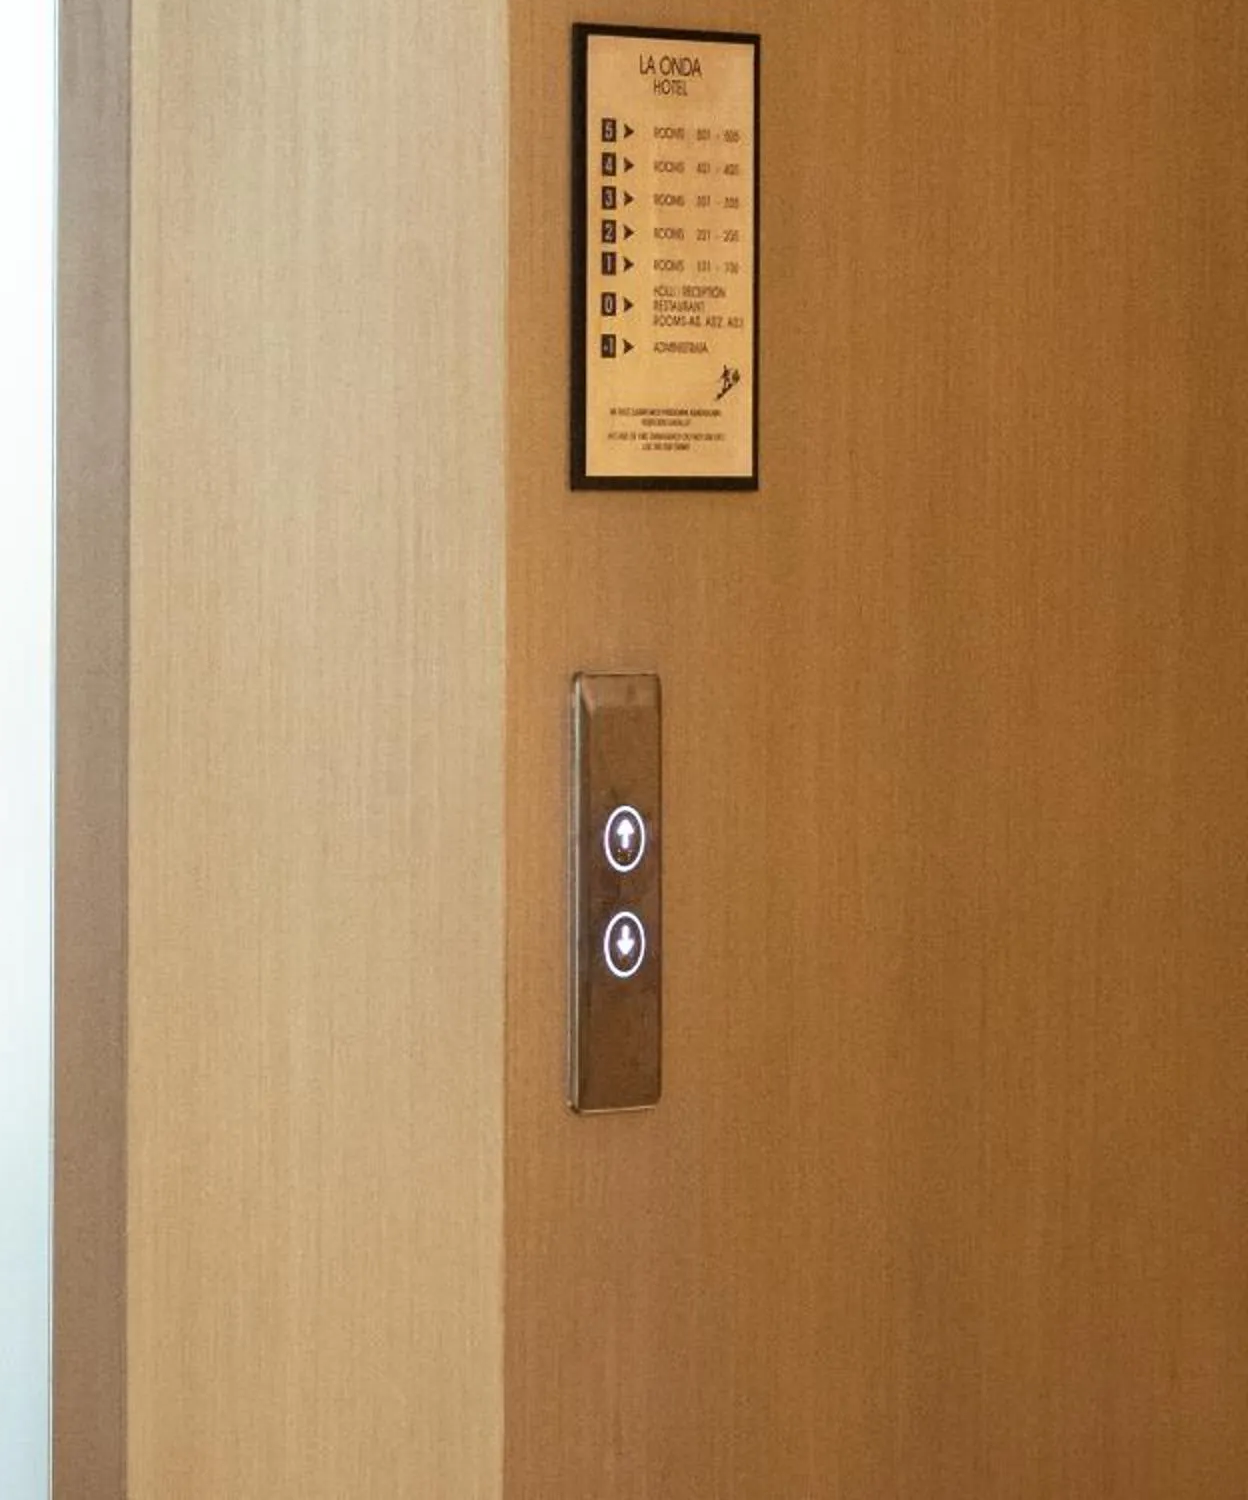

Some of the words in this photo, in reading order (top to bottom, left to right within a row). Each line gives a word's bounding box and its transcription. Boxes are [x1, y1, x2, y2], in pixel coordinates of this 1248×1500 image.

[639, 53, 656, 75] LA
[659, 55, 702, 78] ONDA
[654, 78, 688, 96] HOTEL
[604, 121, 614, 139] 5
[604, 155, 614, 173] 4
[604, 188, 614, 207] 3
[604, 222, 614, 240] 2
[604, 295, 614, 313] 0
